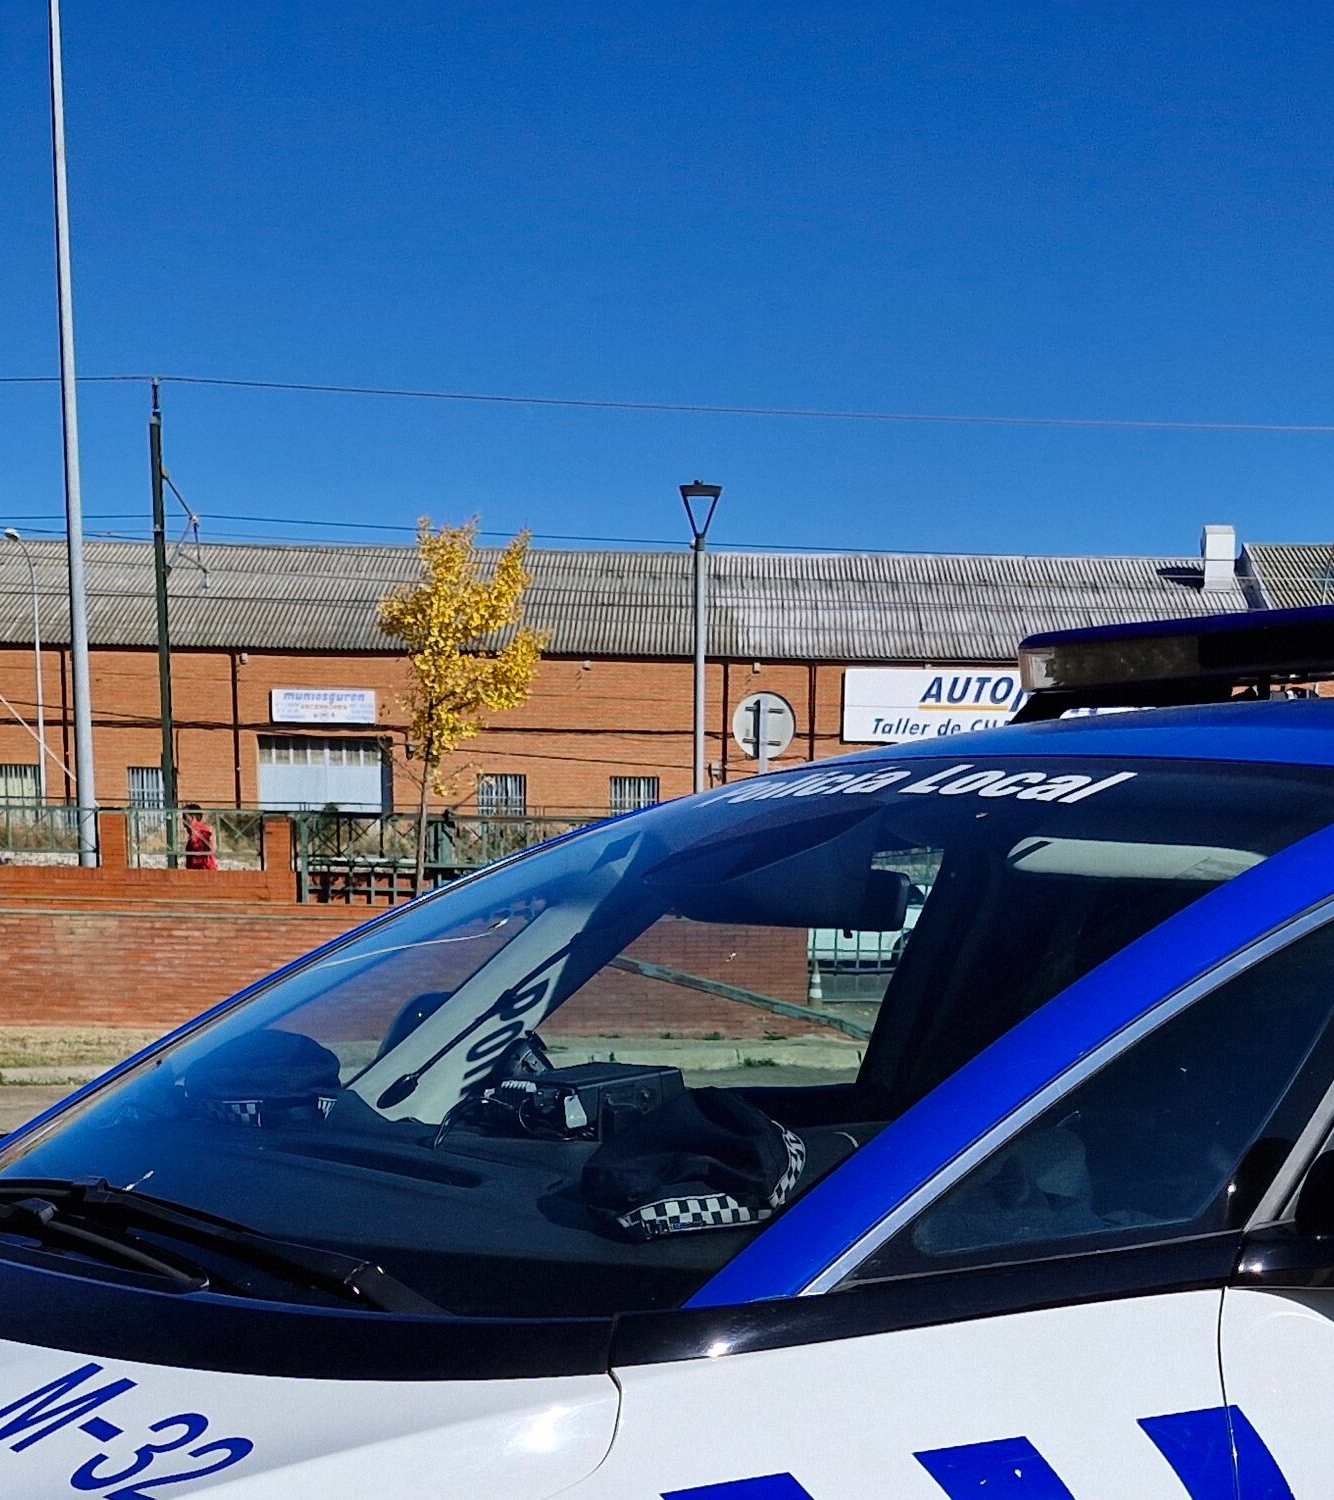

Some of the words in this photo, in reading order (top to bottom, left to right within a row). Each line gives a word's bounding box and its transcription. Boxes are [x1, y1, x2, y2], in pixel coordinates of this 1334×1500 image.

[919, 676, 1027, 712] AUTO
[872, 718, 930, 736] Taller
[898, 764, 1137, 803] Local
